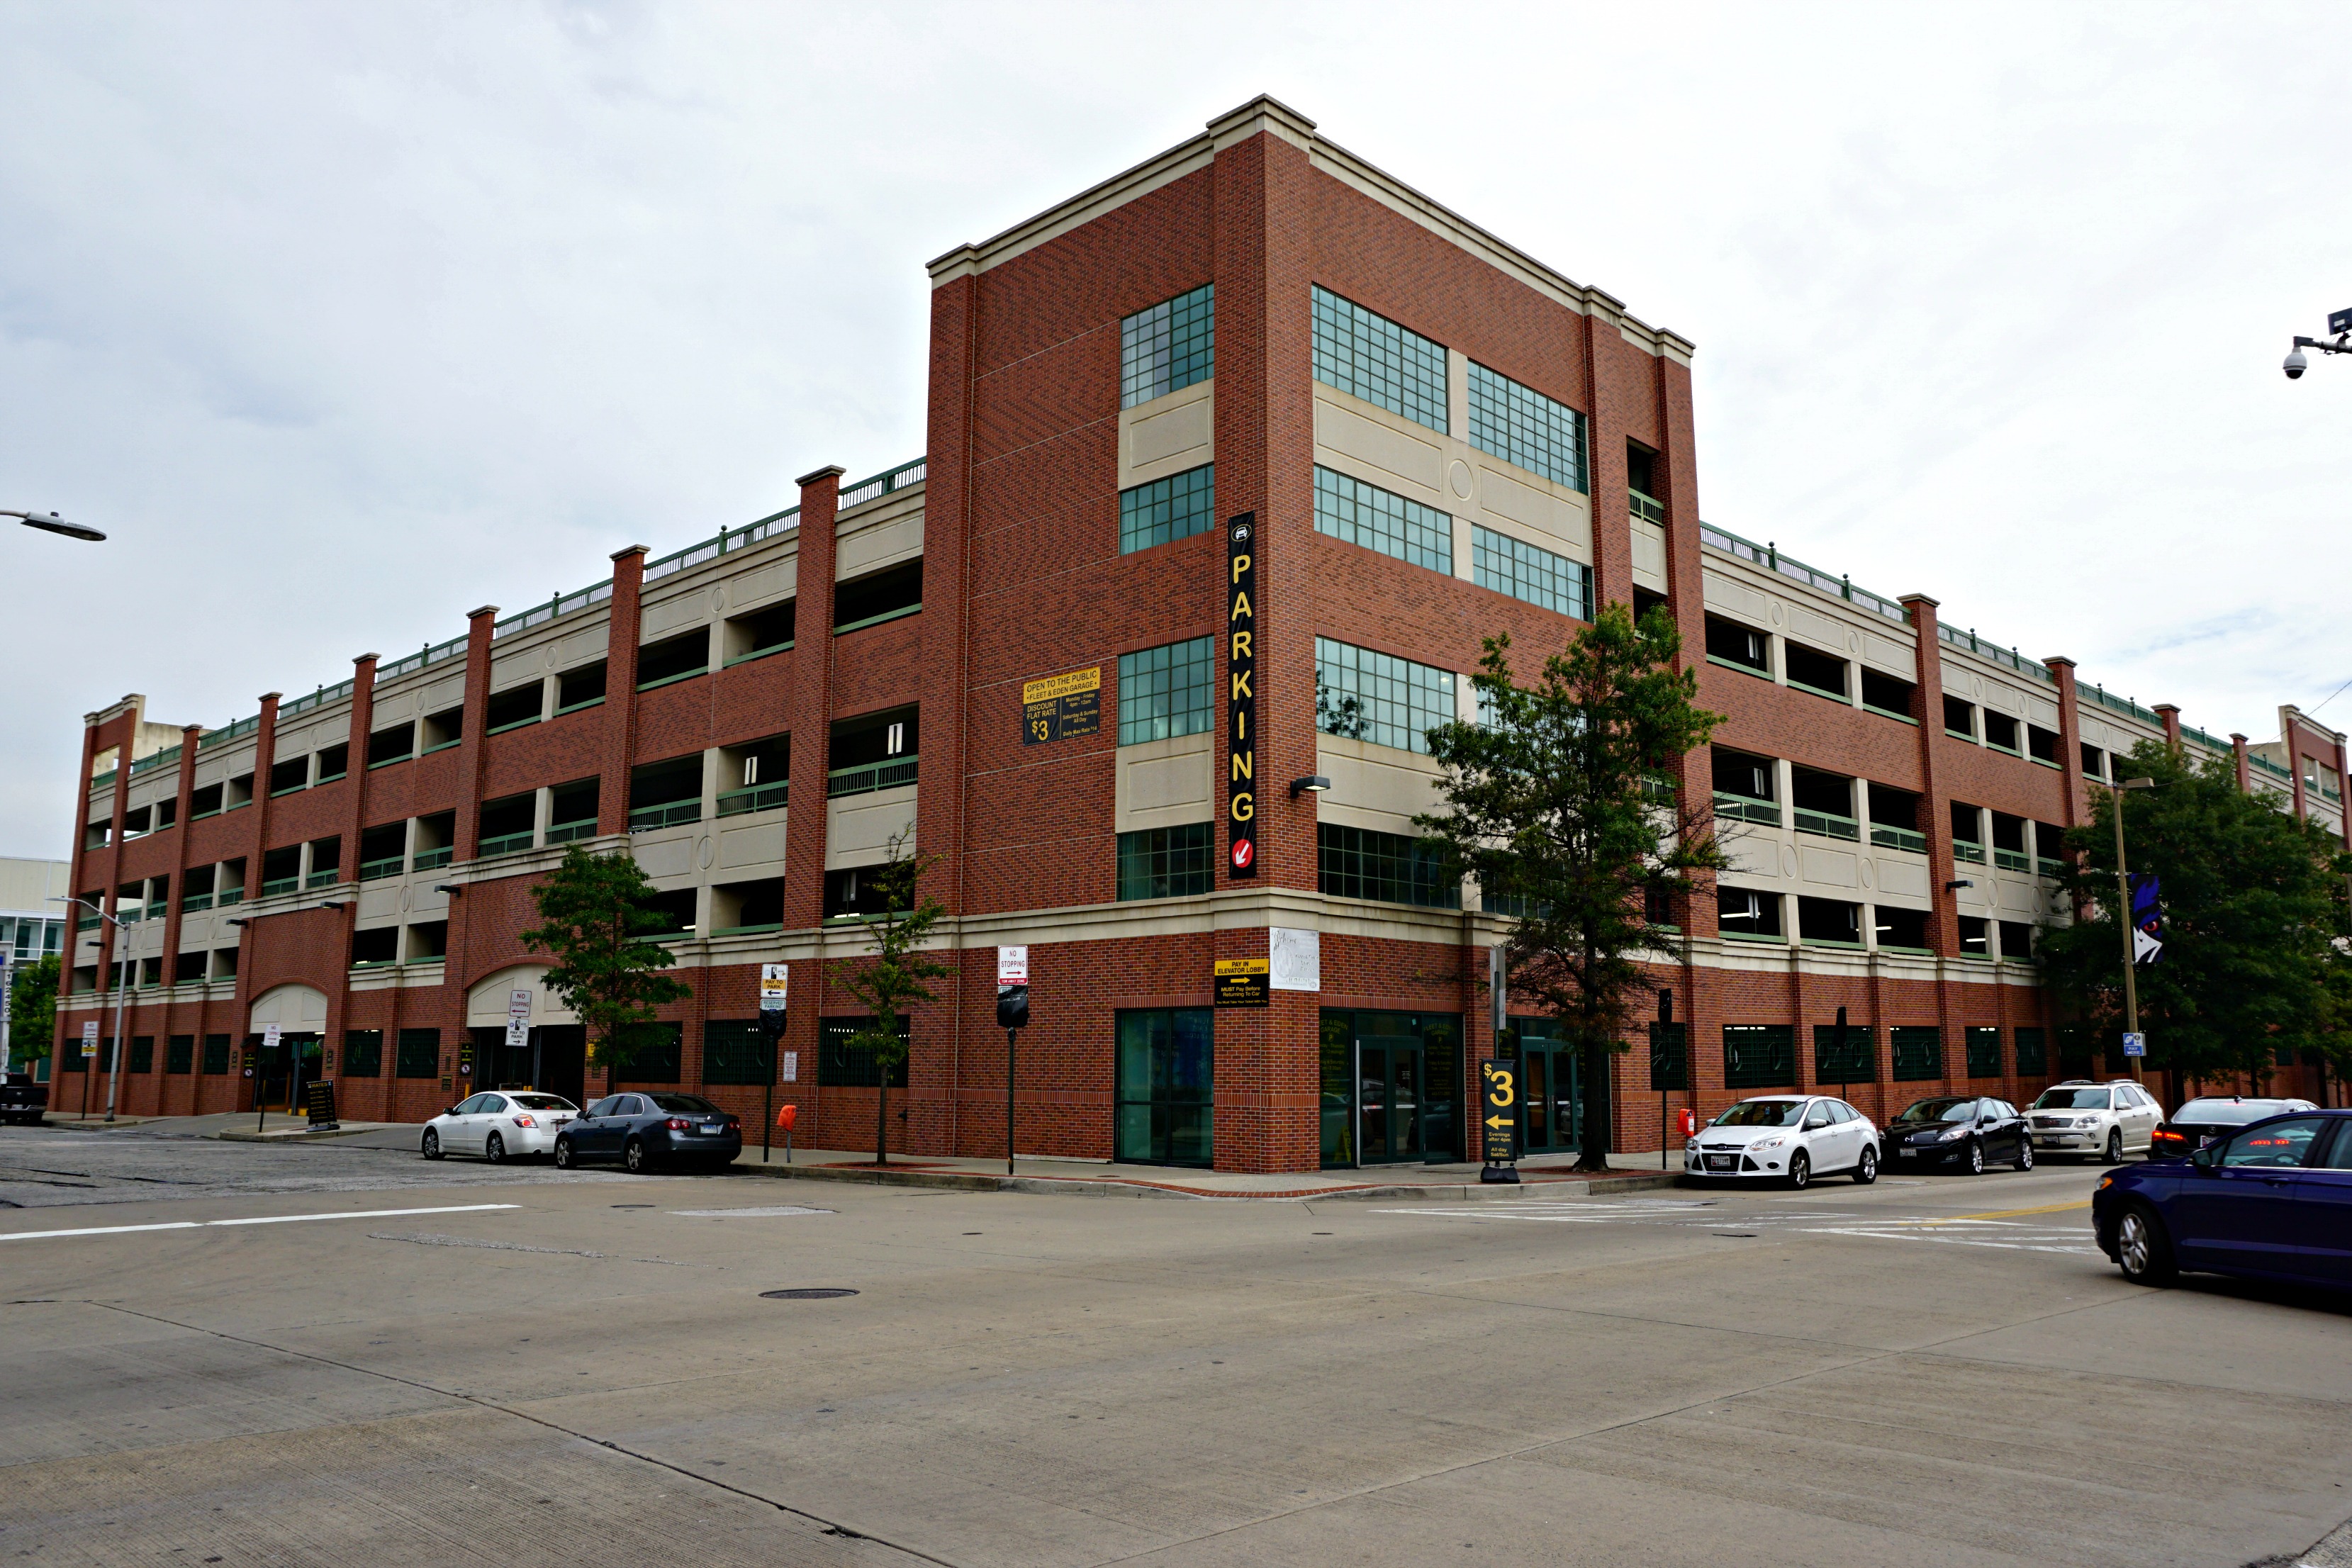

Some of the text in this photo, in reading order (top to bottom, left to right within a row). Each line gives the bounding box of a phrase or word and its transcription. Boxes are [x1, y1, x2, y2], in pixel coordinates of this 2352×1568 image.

[1026, 682, 1045, 692] OPEN
[1057, 676, 1070, 685] THE
[1072, 671, 1097, 682] PUBLIC
[1029, 690, 1046, 700] FLEET
[1053, 686, 1068, 695] EDEN
[1070, 681, 1093, 692] GARAGE
[1231, 554, 1253, 822] PARKING
[1027, 700, 1057, 712] DISCOUNT
[1027, 708, 1056, 720] FLAT RATE
[1032, 720, 1048, 740] $3
[1484, 1063, 1513, 1107] $3
